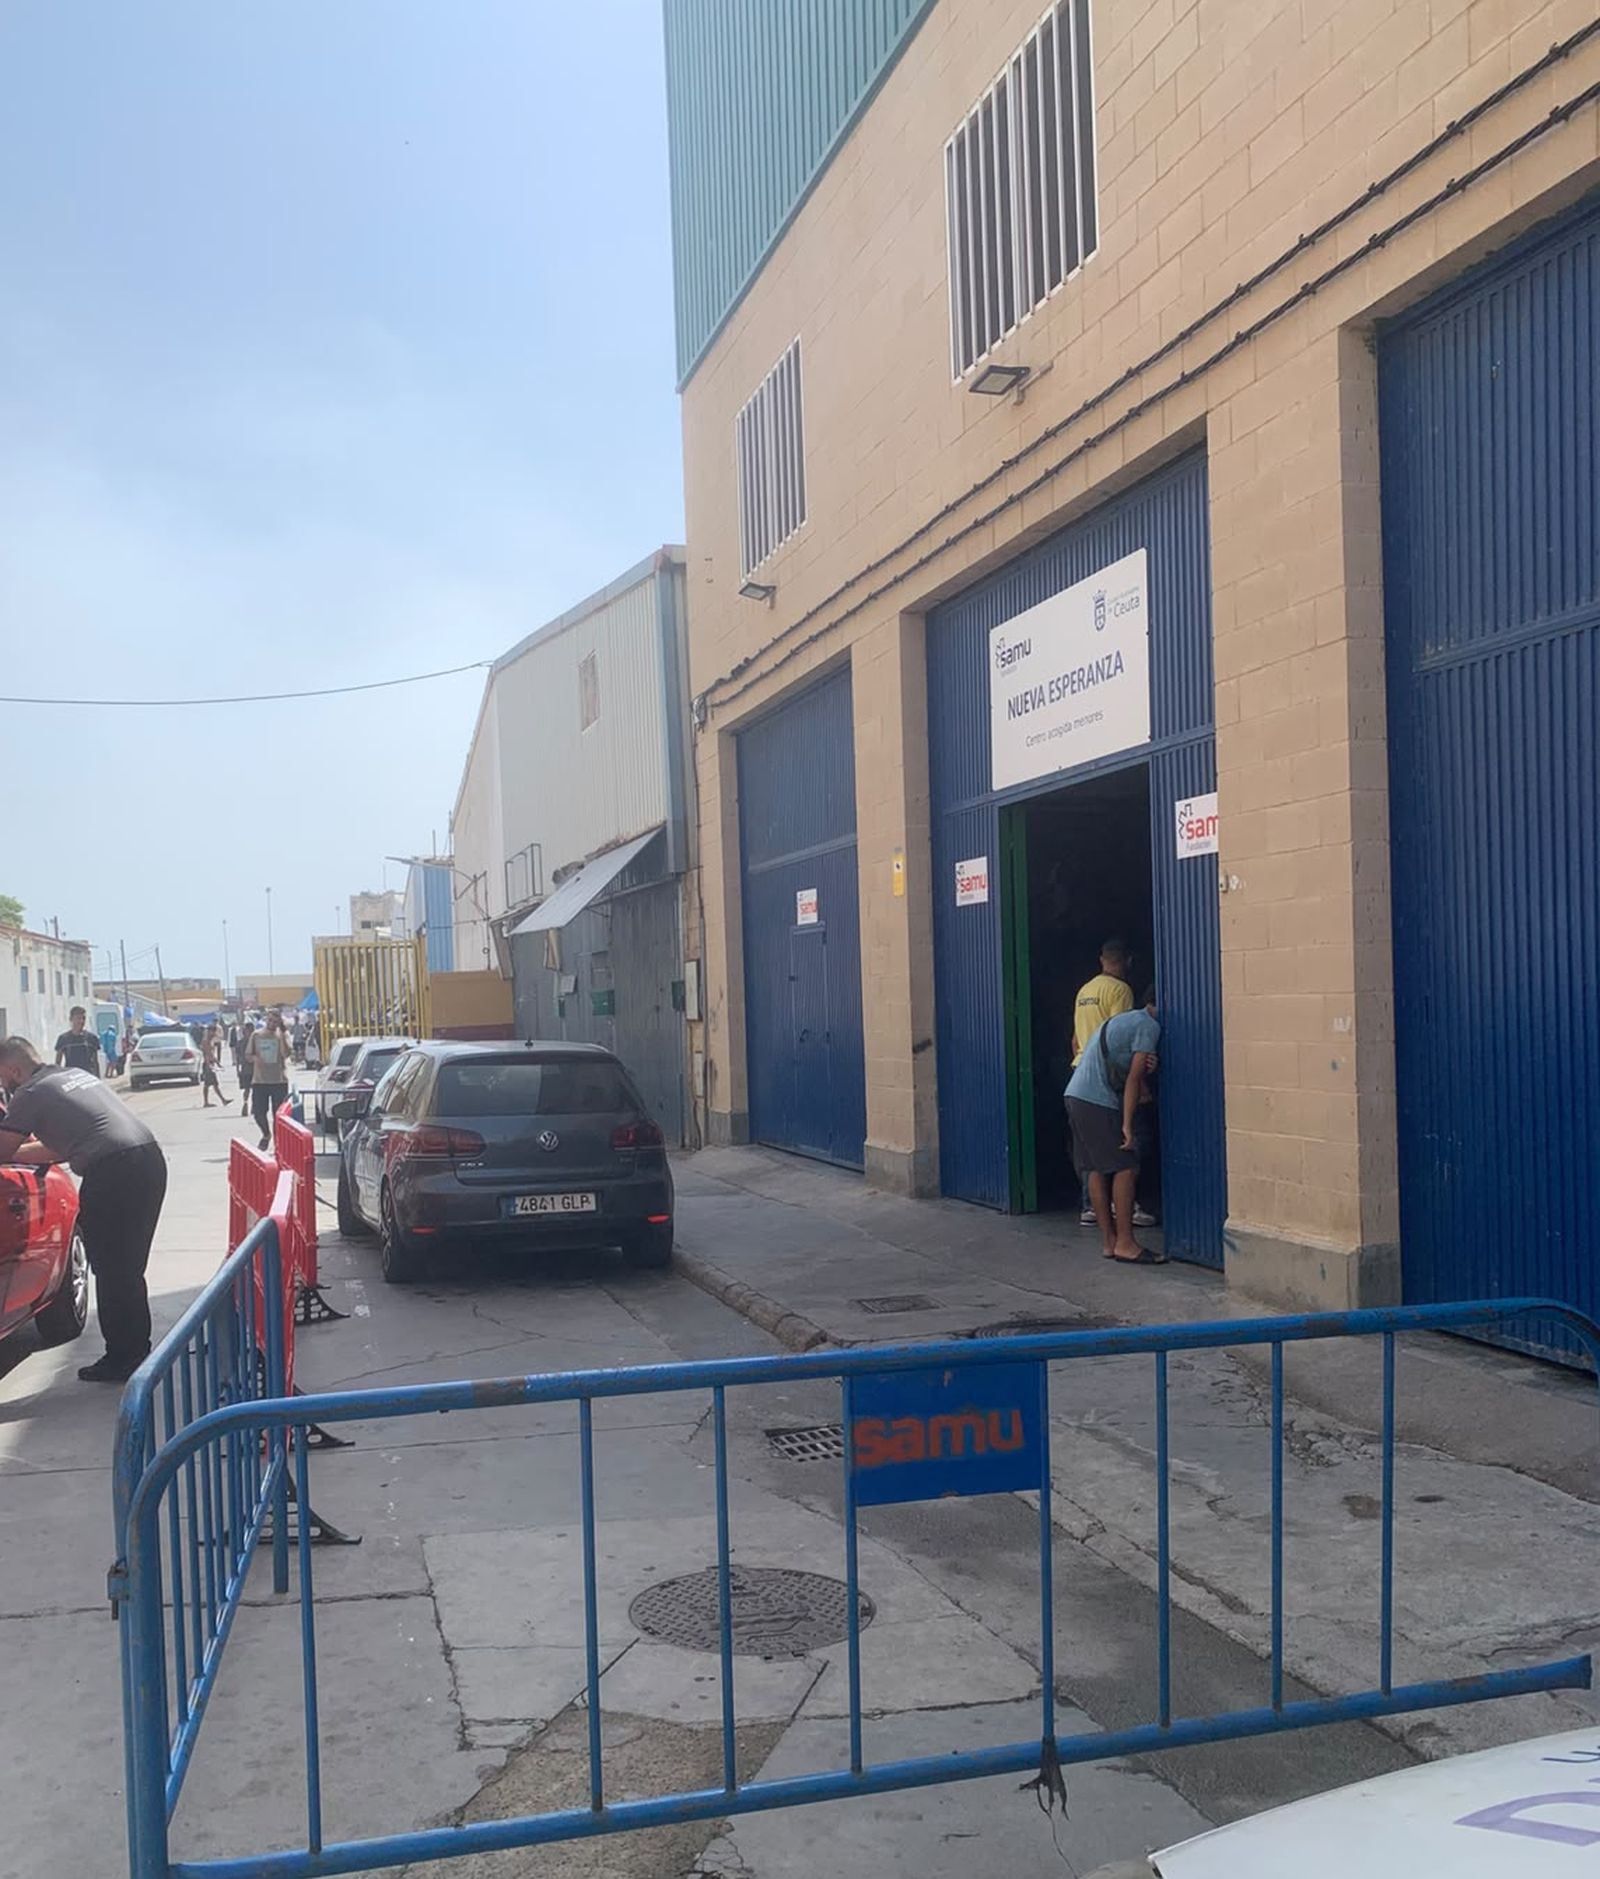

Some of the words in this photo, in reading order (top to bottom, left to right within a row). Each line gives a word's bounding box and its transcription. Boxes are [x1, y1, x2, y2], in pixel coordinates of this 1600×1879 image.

[1113, 595, 1141, 618] Ceuta
[1000, 638, 1032, 668] samu
[1007, 684, 1047, 721] NUEVA
[1049, 649, 1125, 704] ESPERANZA
[1025, 732, 1046, 747] Centro
[1047, 722, 1073, 739] acogida
[1073, 709, 1104, 729] menores
[1186, 814, 1219, 841] sam
[960, 874, 987, 894] samu
[519, 1197, 556, 1212] 4841
[561, 1194, 591, 1210] GLP
[854, 1409, 1023, 1468] samu
